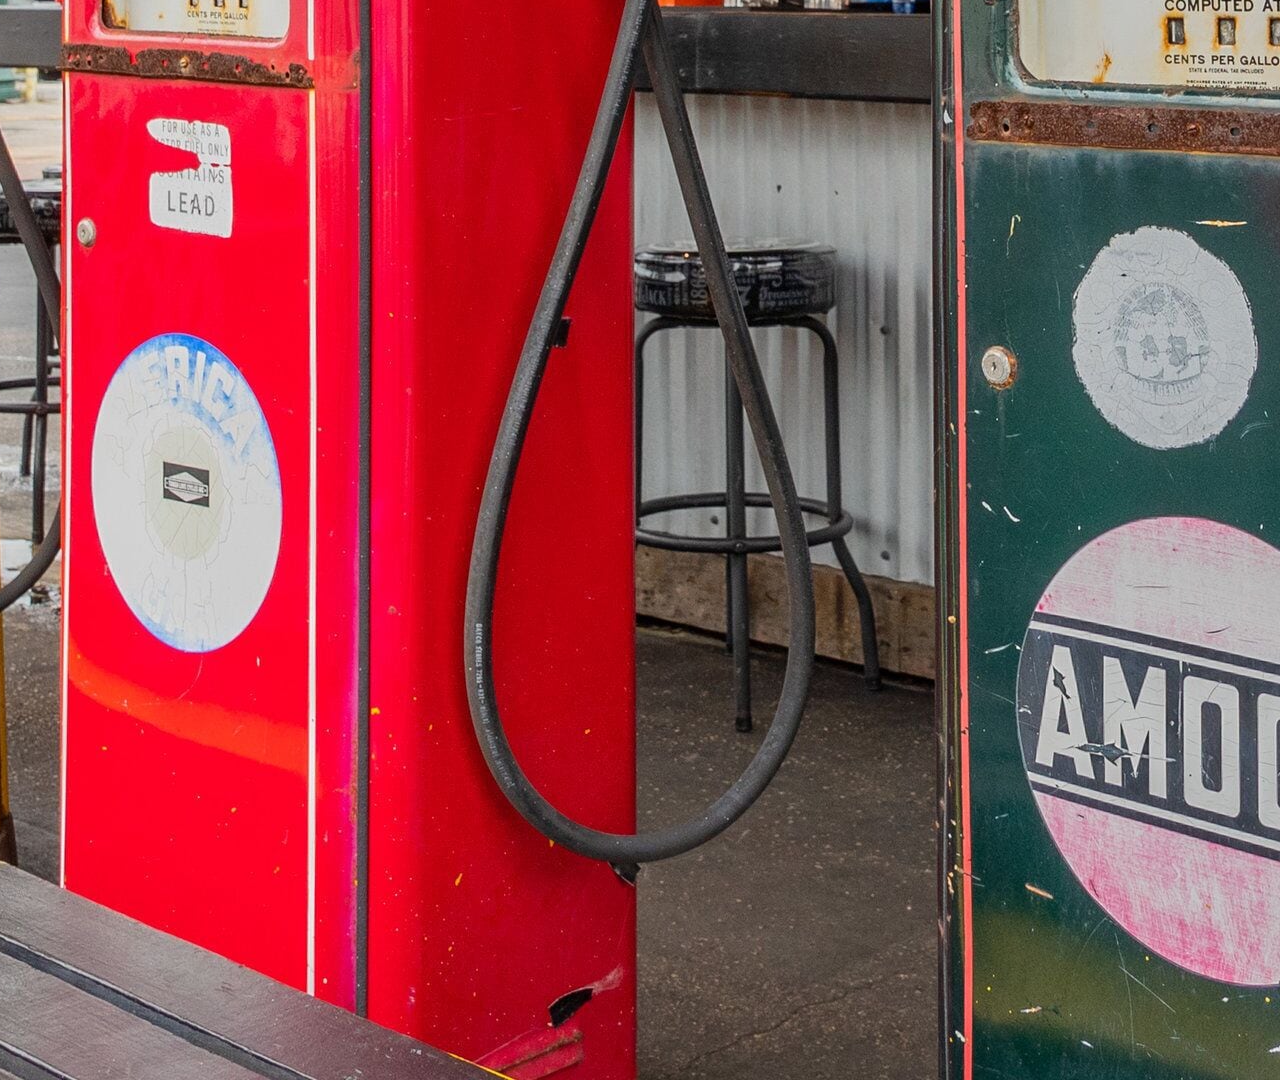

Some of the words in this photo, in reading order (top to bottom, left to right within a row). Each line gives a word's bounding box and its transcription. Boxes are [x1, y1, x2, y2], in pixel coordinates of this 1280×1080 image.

[210, 11, 222, 19] PER
[224, 12, 248, 20] GALLON
[1164, 54, 1205, 65] CENTS
[1211, 55, 1235, 65] PER
[162, 120, 178, 133] FOR
[181, 121, 197, 135] USE
[200, 124, 211, 137] AS
[214, 126, 220, 138] A
[208, 143, 229, 157] ONLY
[167, 190, 215, 216] LEAD
